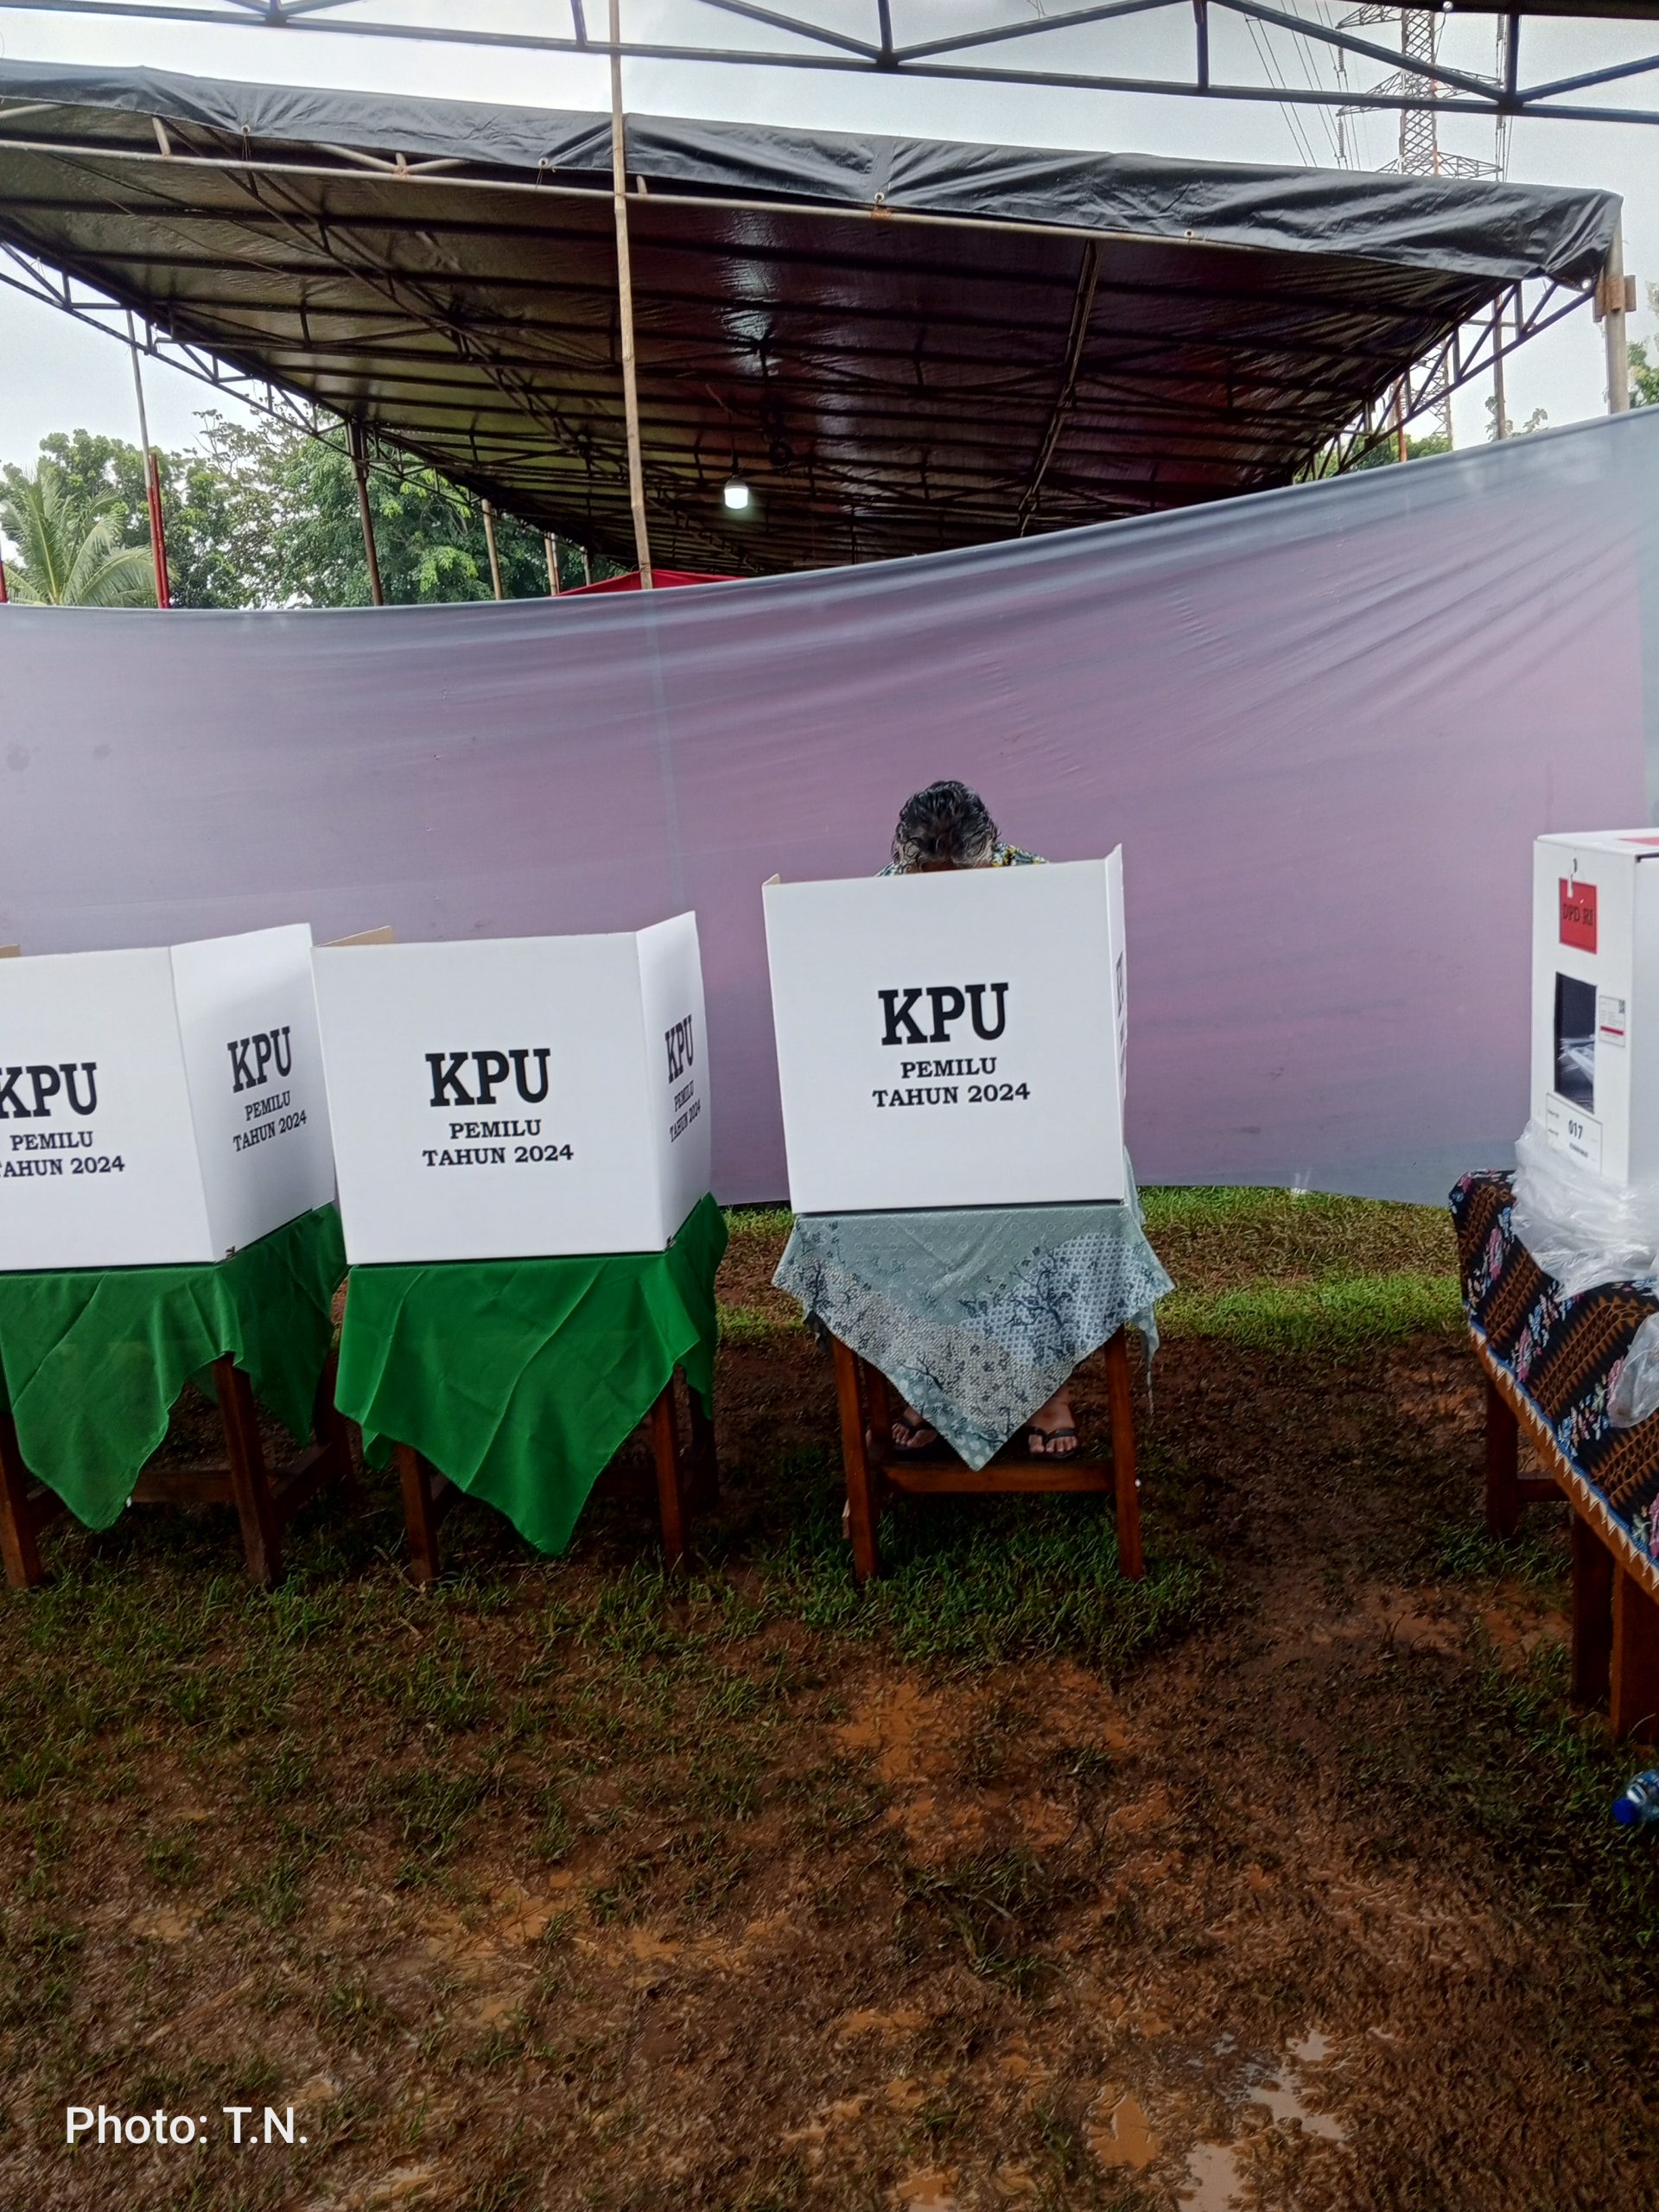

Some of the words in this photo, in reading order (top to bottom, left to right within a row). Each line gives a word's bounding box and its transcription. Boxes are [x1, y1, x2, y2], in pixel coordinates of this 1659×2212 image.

[1562, 903, 1580, 923] DPD
[1582, 907, 1594, 927] RI
[878, 982, 1009, 1046] KPU
[226, 1026, 292, 1094] KPU
[664, 1014, 694, 1084] KPU
[425, 1047, 551, 1107] KPU
[900, 1057, 997, 1078] PEMILU
[0, 1062, 97, 1119] KPU
[673, 1080, 695, 1113] PEMILU
[872, 1086, 959, 1108] TAHUN
[967, 1082, 1031, 1103] 2024
[245, 1090, 291, 1122] PEMILU
[10, 1131, 93, 1151] PEMILU
[232, 1122, 276, 1152] TAHUN
[278, 1109, 308, 1135] 2024
[448, 1119, 542, 1140] PEMILU
[1568, 1119, 1583, 1140] 017
[0, 1159, 63, 1178] AHUN
[70, 1155, 125, 1174] 2024
[422, 1147, 505, 1166] TAHUN
[514, 1144, 575, 1163] 2024
